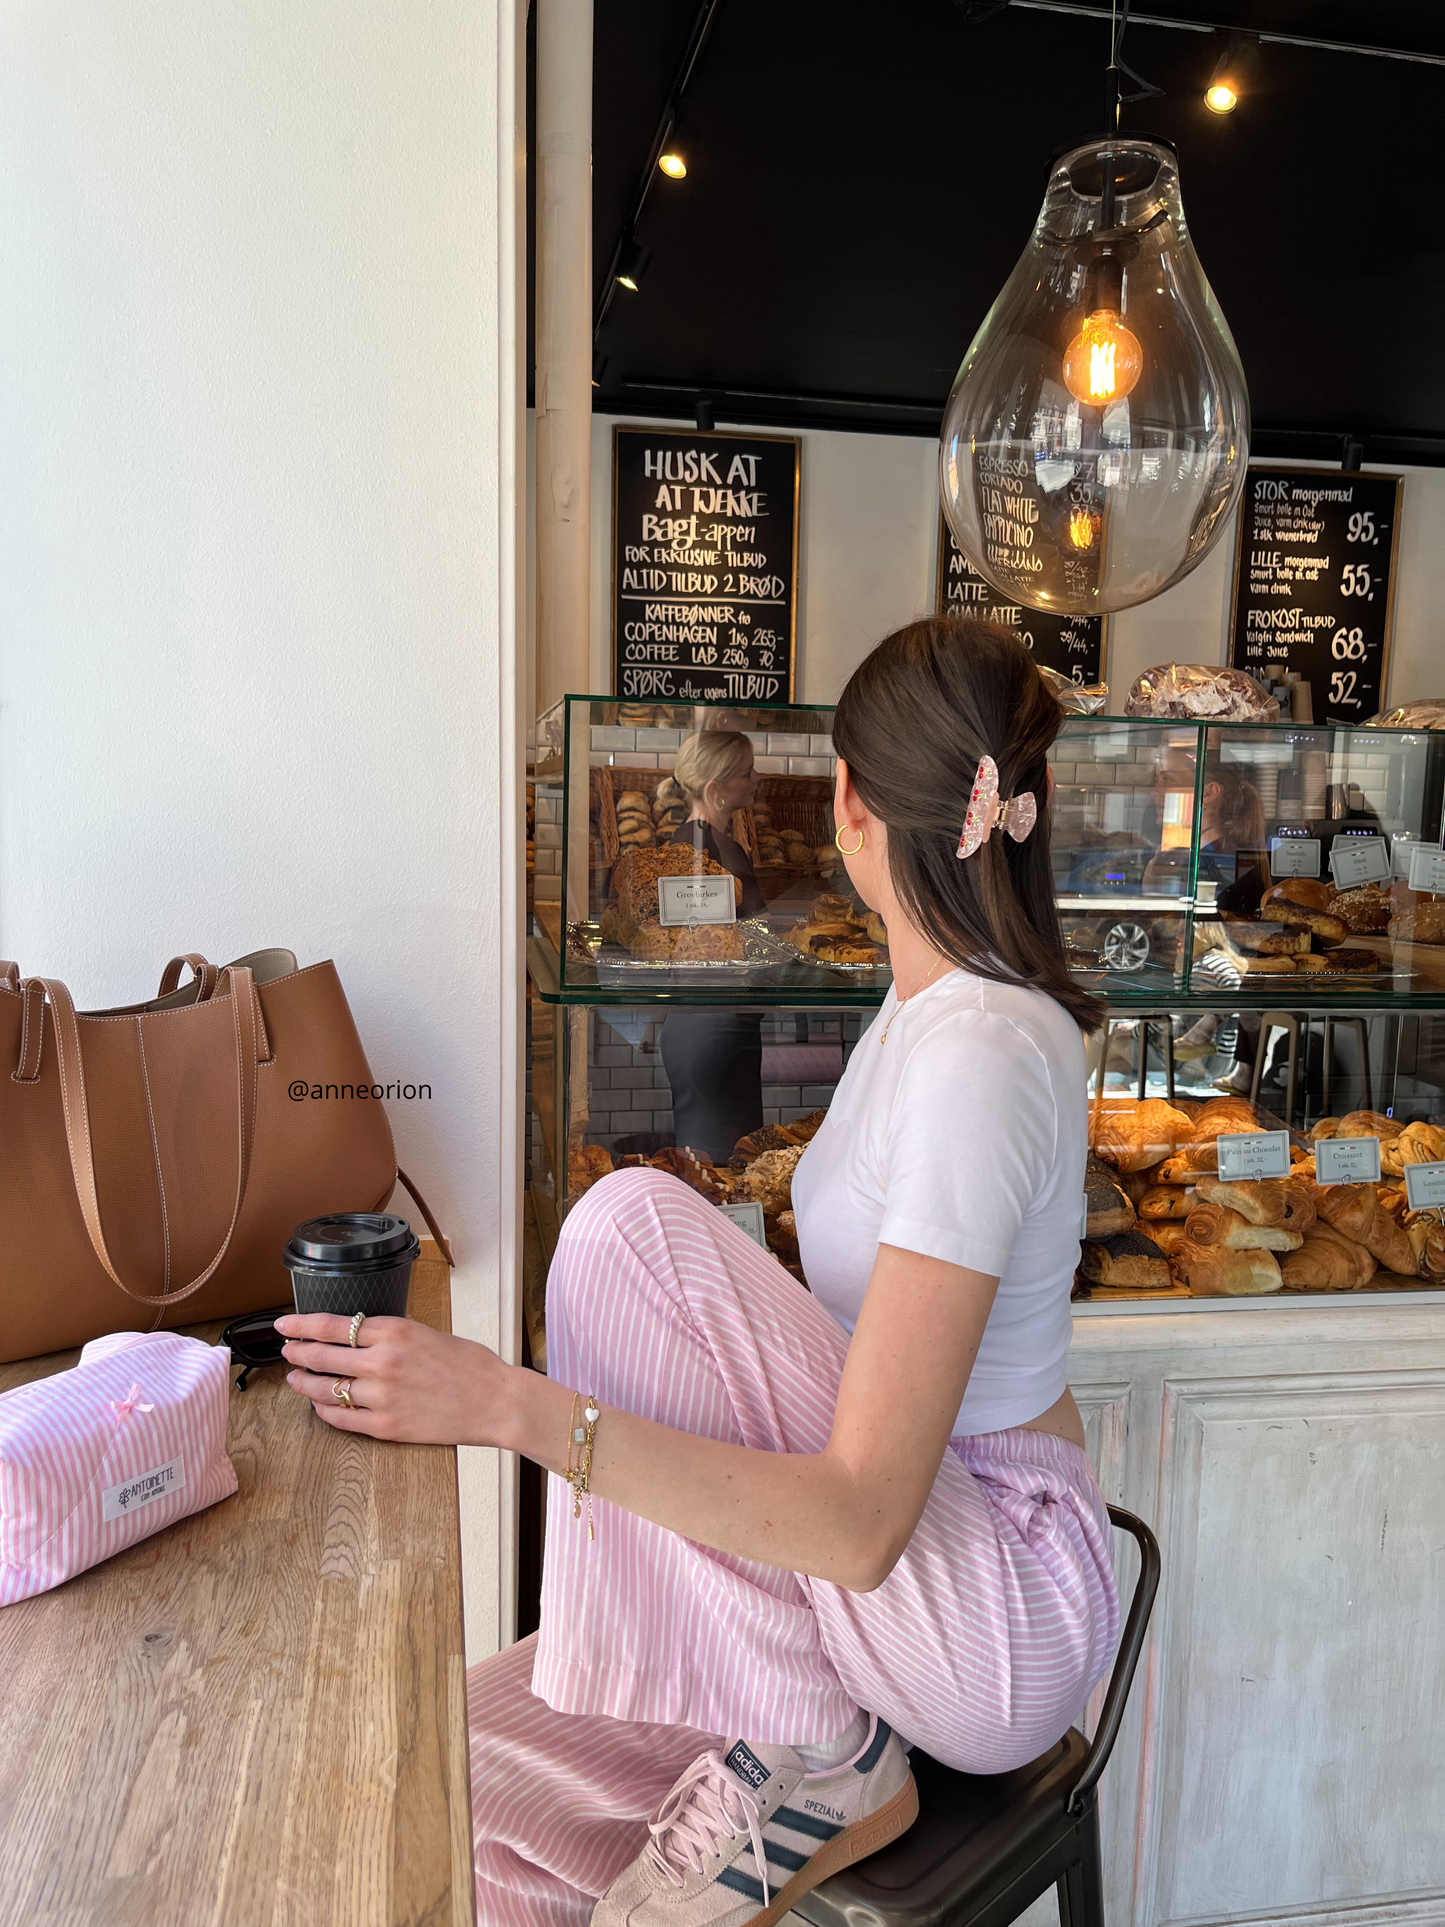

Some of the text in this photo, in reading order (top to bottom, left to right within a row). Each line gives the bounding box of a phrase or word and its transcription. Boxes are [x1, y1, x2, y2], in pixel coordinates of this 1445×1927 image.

[644, 450, 762, 487] HUSK AT
[979, 455, 1029, 478] ESPRESSO
[980, 471, 1024, 495] CORTADO
[1254, 480, 1353, 508] STOR morgenmad
[654, 484, 770, 518] AT TJEKKE
[982, 486, 1040, 524] FLAT WHITE
[625, 546, 651, 563] FOR
[724, 551, 767, 569] TILBUD
[1250, 550, 1330, 572] LILLE morgenmad
[622, 567, 785, 599] ALTID TILBUD 2 BRØD
[947, 581, 989, 602] LATTE
[644, 603, 751, 627] KAFFEBØNNER fra
[1247, 607, 1336, 630] FROKOST TILBUD
[624, 621, 718, 645] COPENHAGEN
[625, 643, 680, 662] COFFEE
[691, 646, 719, 666] LAB
[721, 648, 750, 670] 250g
[623, 669, 676, 698] SPØRG
[679, 679, 701, 698] efter
[724, 673, 780, 700] TILBUD
[676, 890, 718, 899] Grovbirkes
[1252, 1145, 1281, 1153] Chocolat
[1333, 1152, 1363, 1160] Croissant
[130, 1466, 174, 1498] ANTOINETTE
[803, 1799, 836, 1820] SPEZIAL
